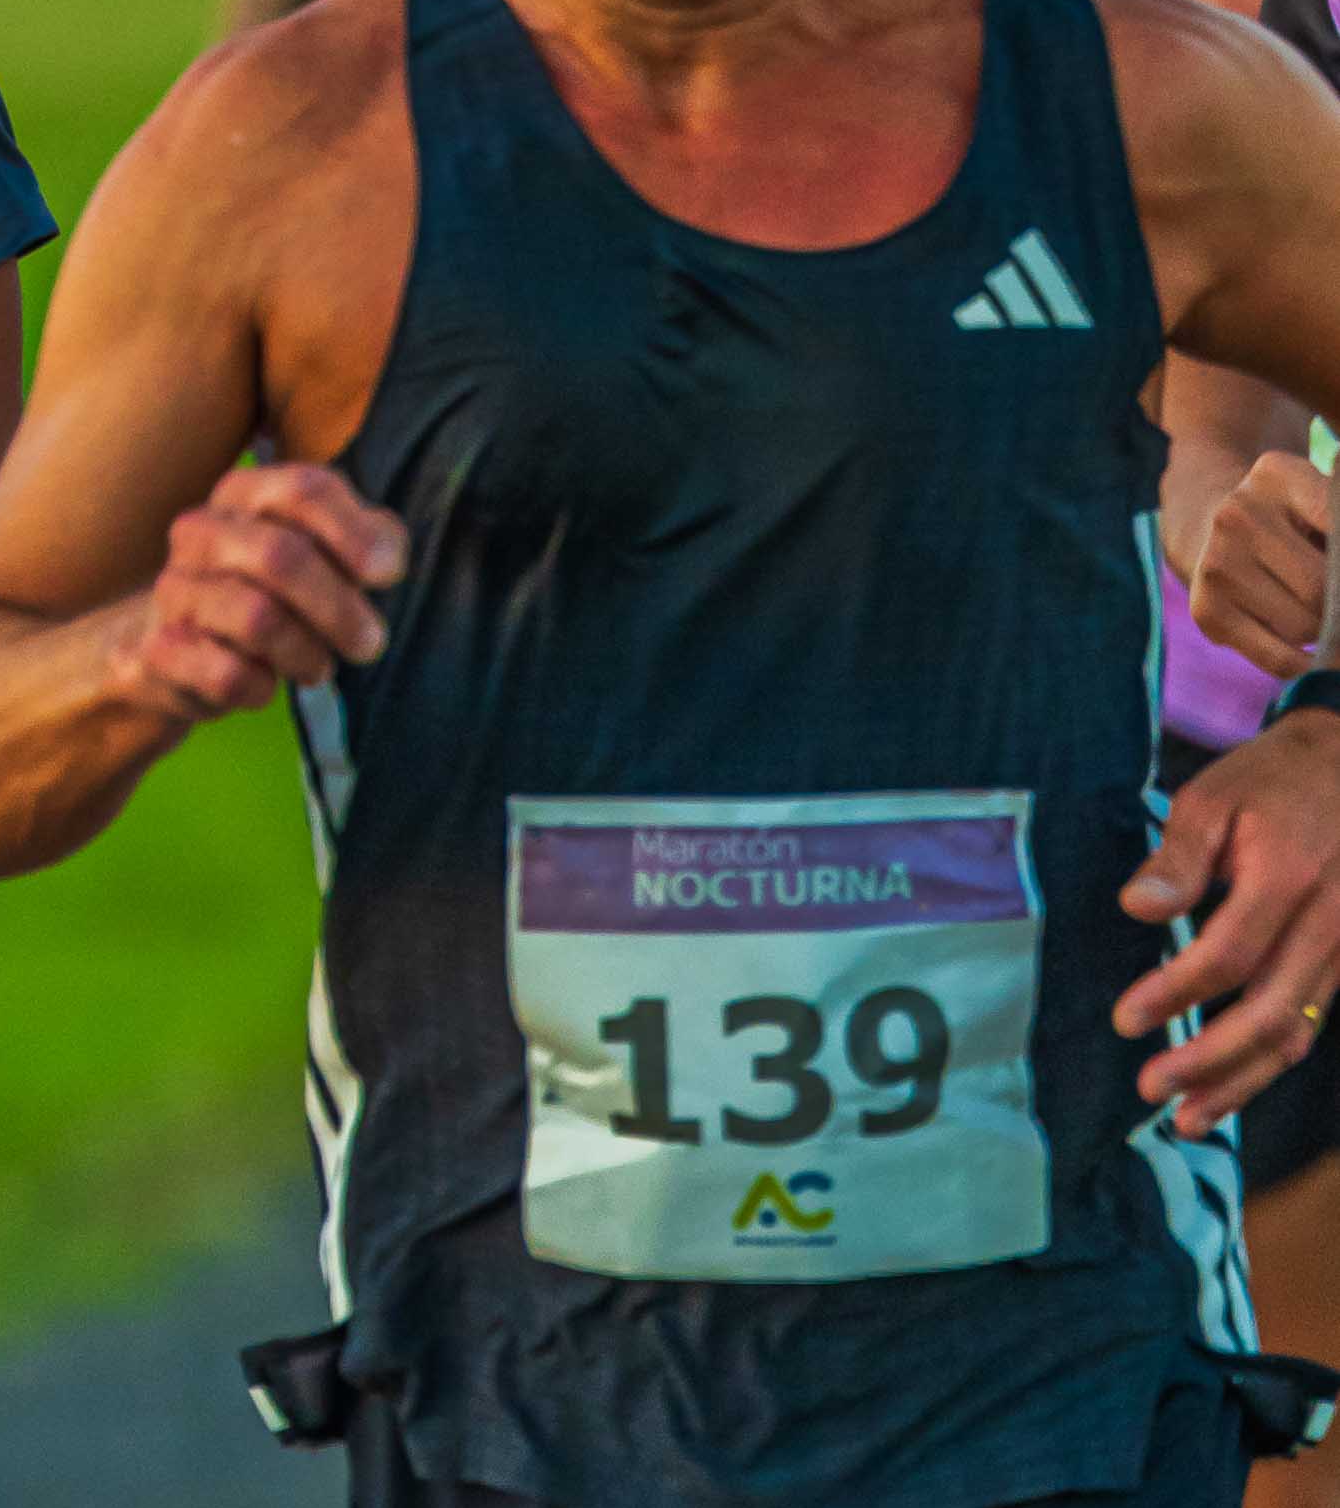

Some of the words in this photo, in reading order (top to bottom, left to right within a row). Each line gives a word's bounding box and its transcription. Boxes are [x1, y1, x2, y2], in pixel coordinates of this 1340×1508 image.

[631, 827, 801, 867] Maratón
[632, 862, 913, 909] NOCTURNA
[598, 984, 951, 1147] 139
